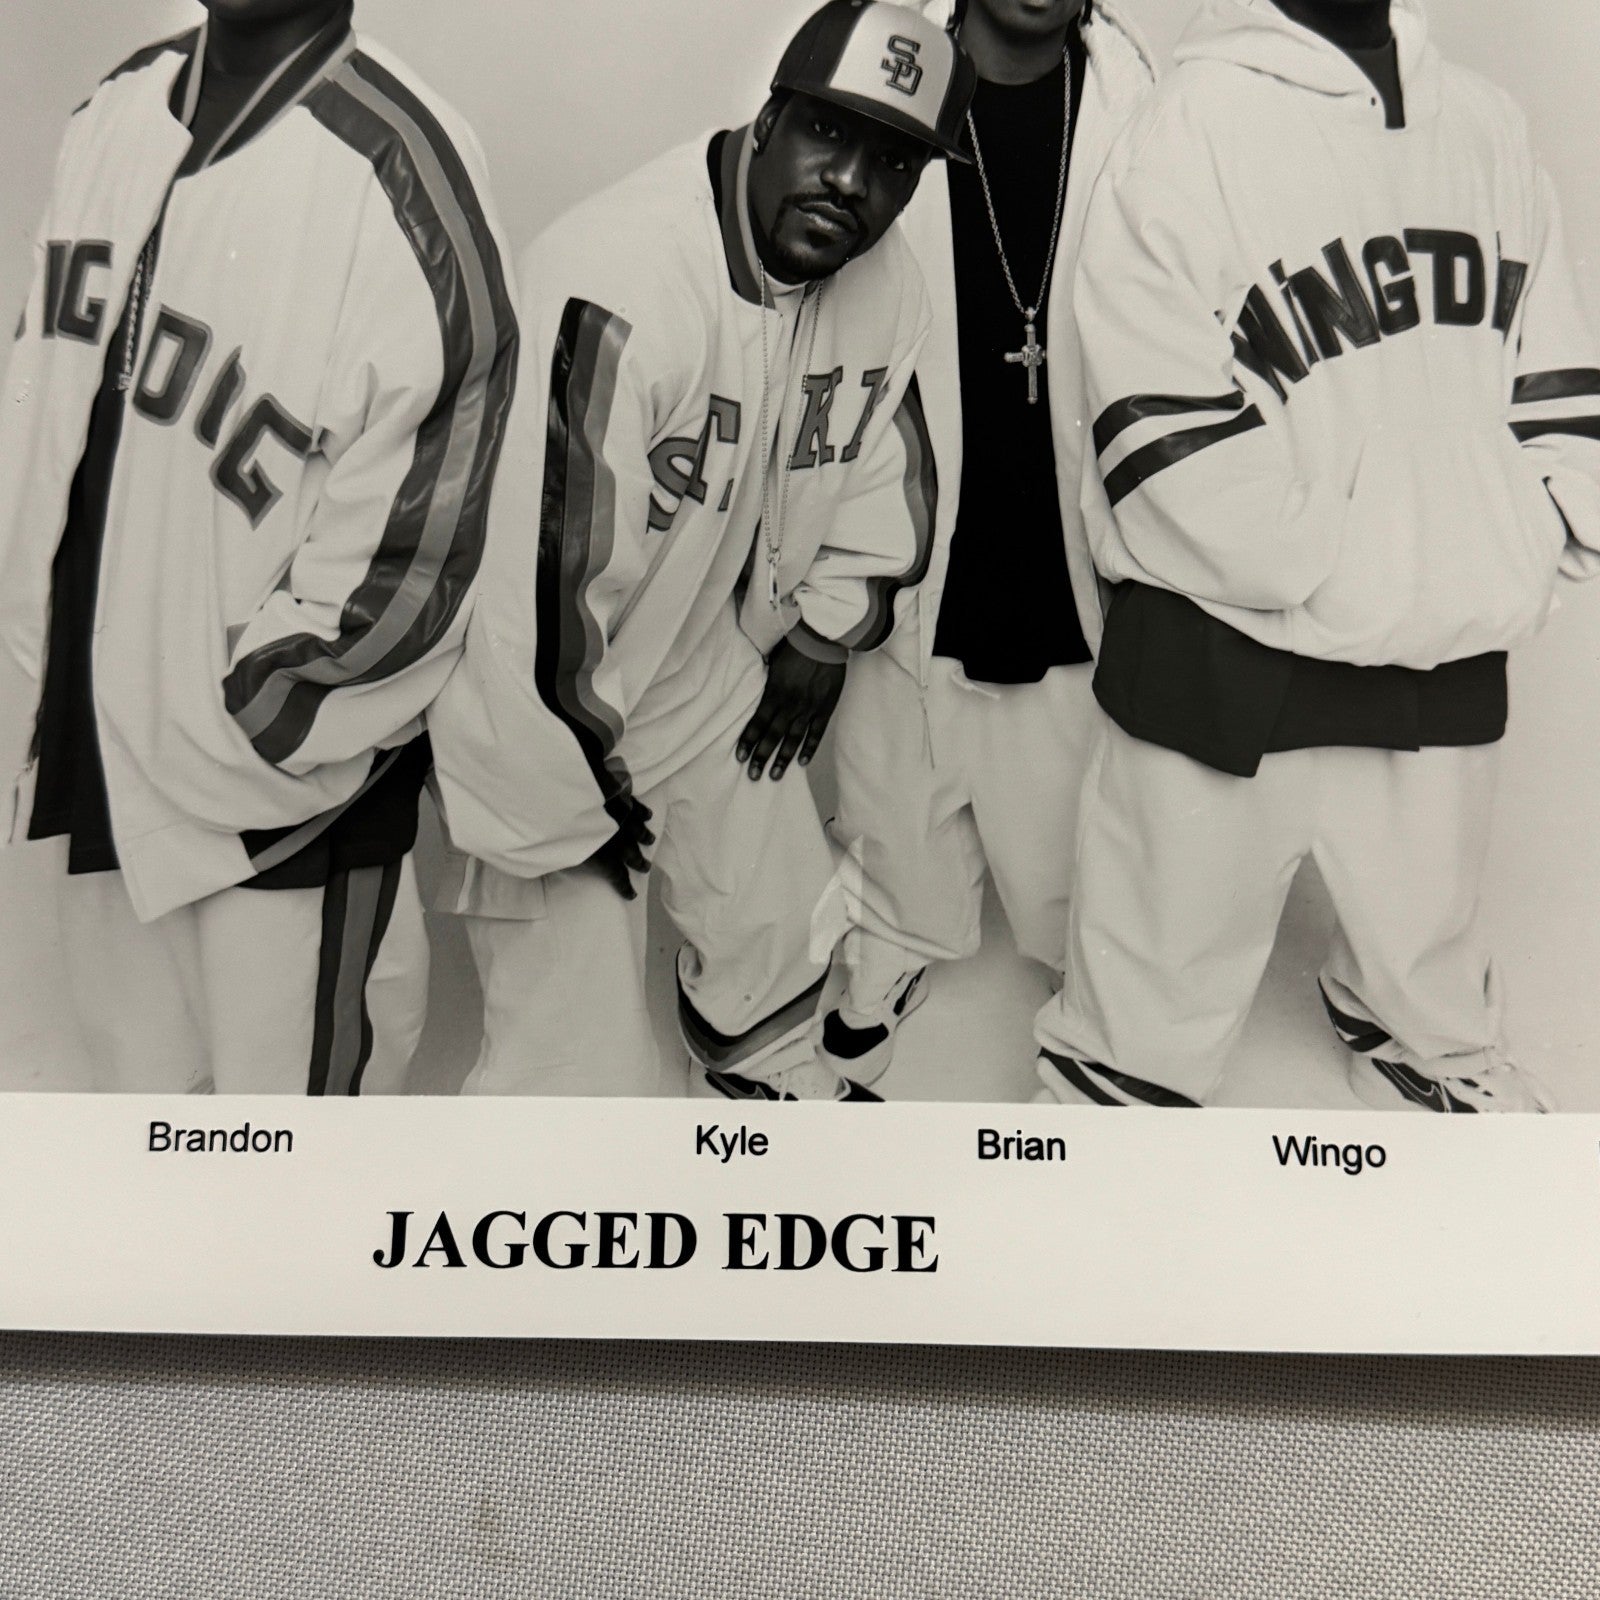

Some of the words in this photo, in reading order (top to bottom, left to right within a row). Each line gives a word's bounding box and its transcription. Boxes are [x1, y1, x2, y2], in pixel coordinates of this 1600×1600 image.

[881, 35, 923, 97] SD
[148, 1121, 294, 1153] Brandon
[696, 1124, 769, 1164] Kyle
[977, 1128, 1066, 1162] Brian
[1272, 1134, 1387, 1176] Wingo
[372, 1210, 698, 1270] JAGGED
[721, 1212, 939, 1273] EDGE
